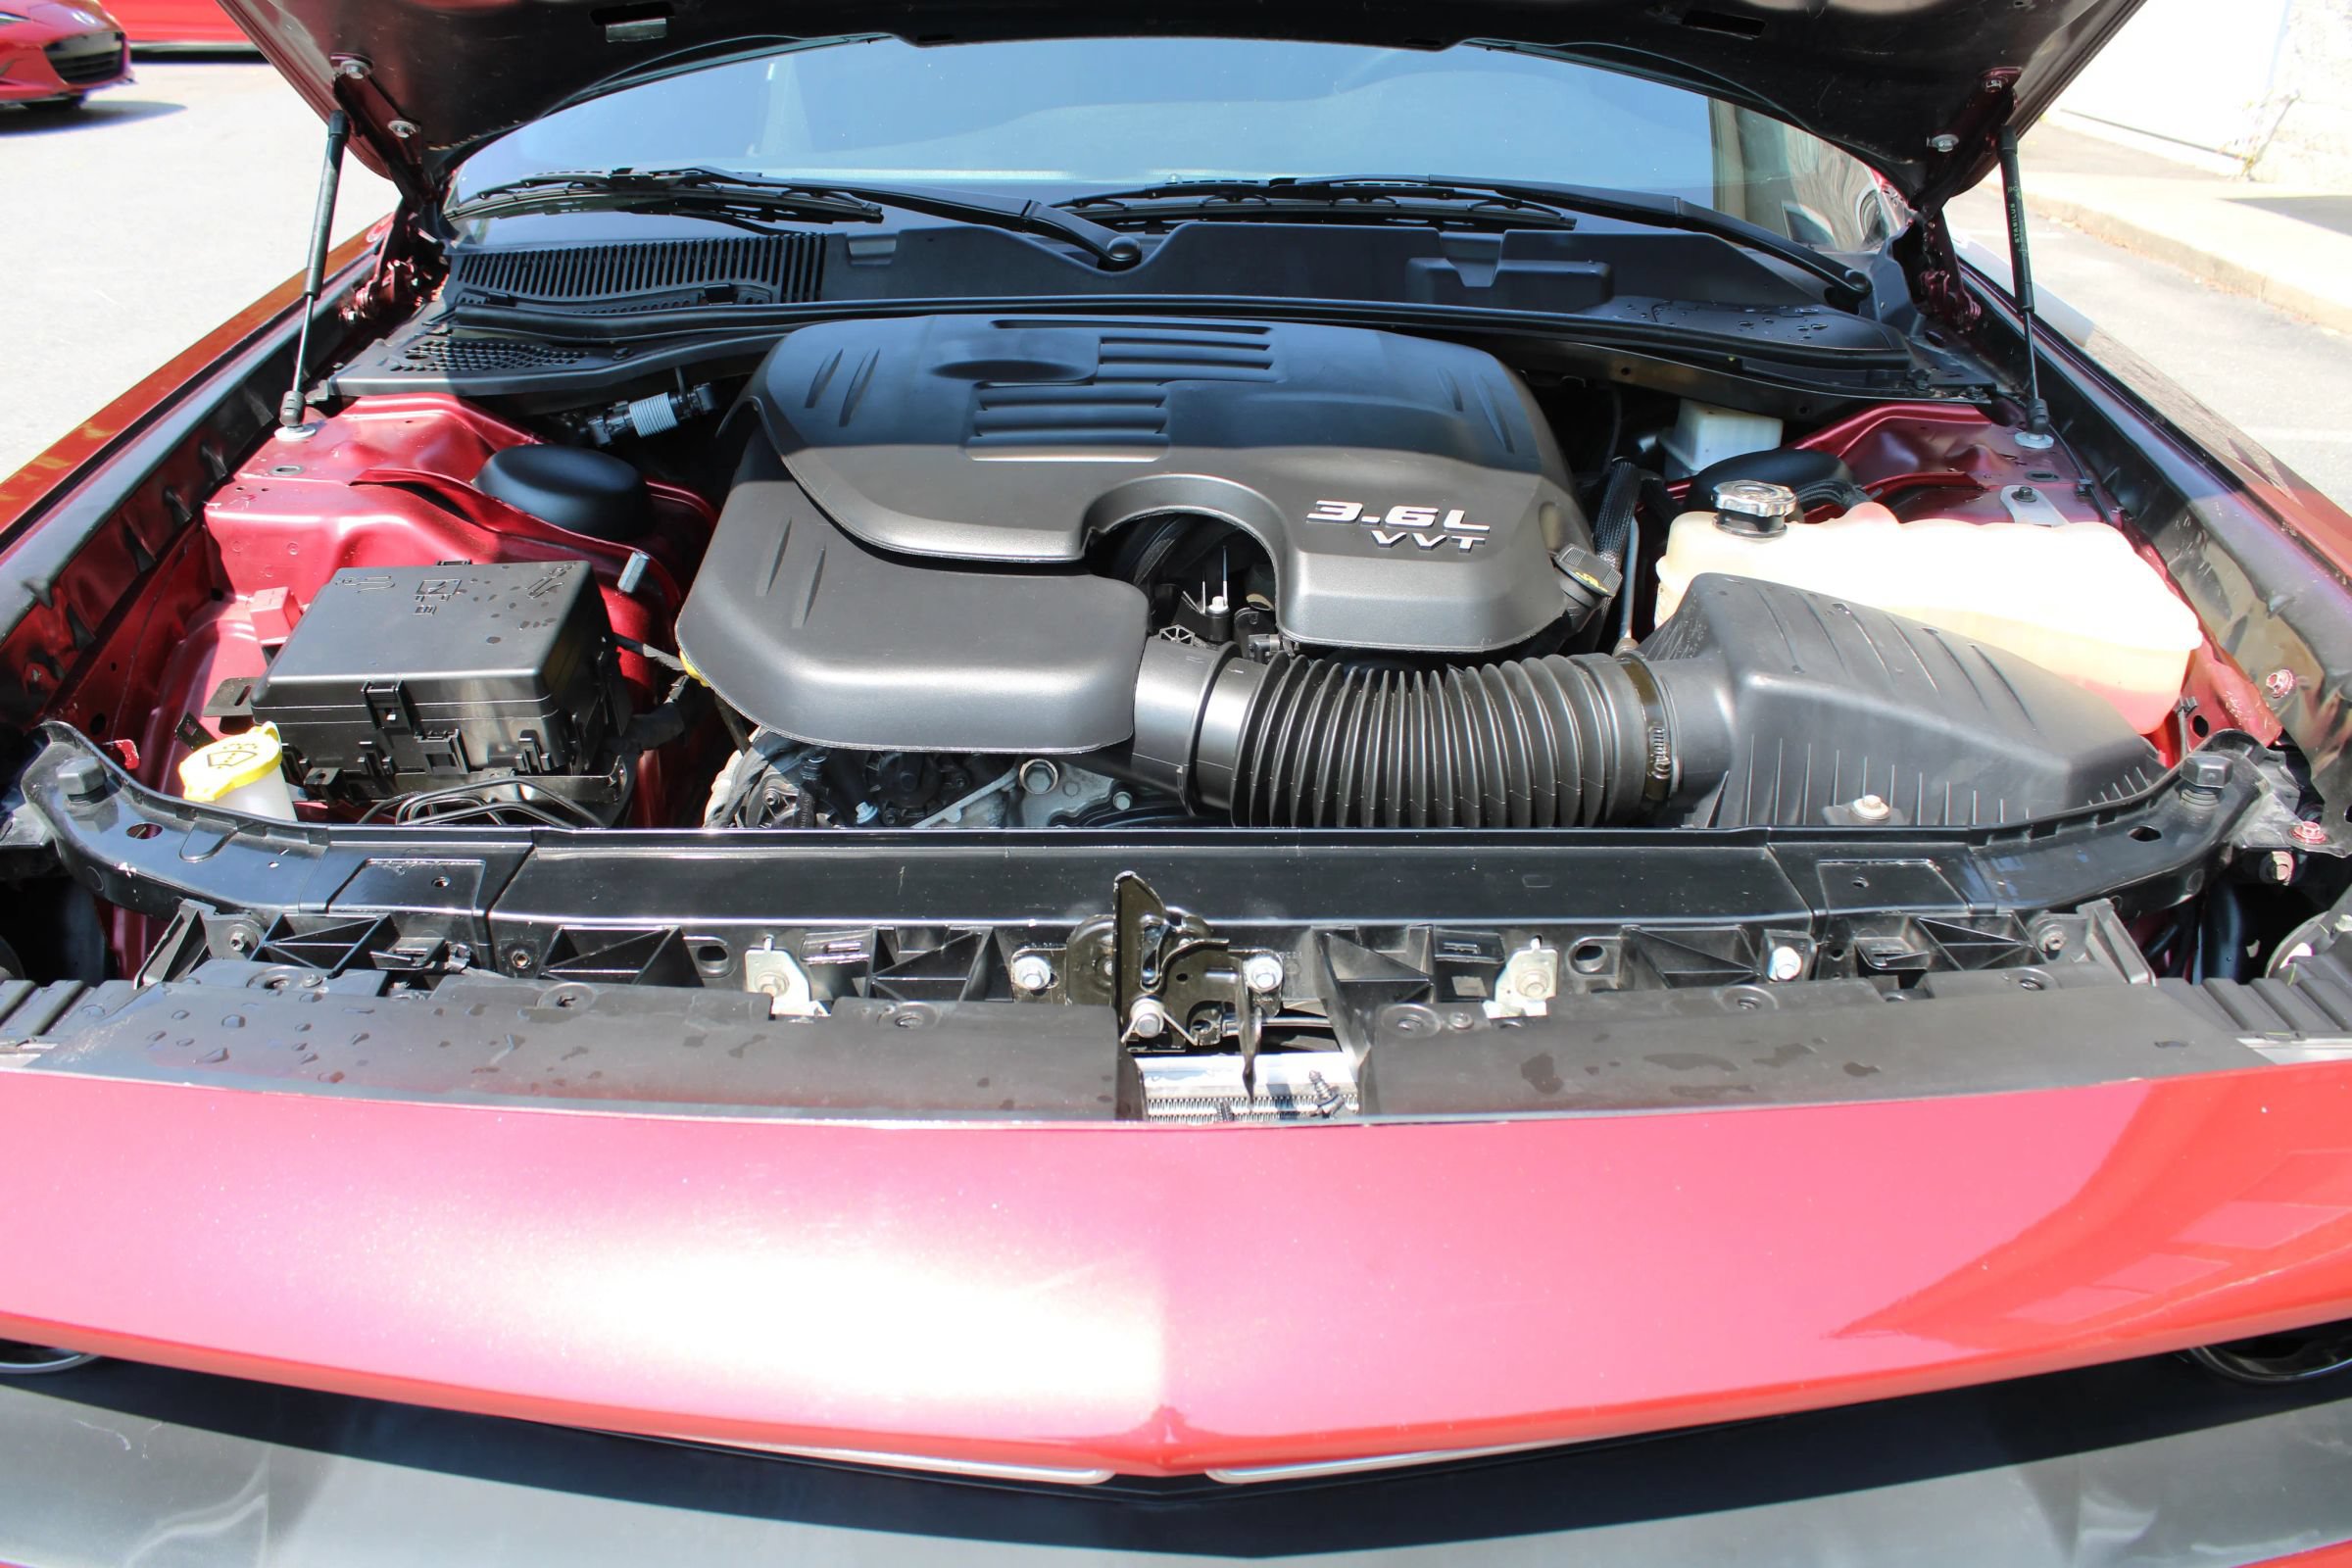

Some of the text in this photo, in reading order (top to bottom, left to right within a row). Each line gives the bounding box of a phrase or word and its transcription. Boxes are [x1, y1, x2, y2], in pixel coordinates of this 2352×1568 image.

[2010, 203, 2020, 244] STABILUS
[1306, 500, 1490, 532] 3.6L
[1372, 530, 1486, 553] VVT
